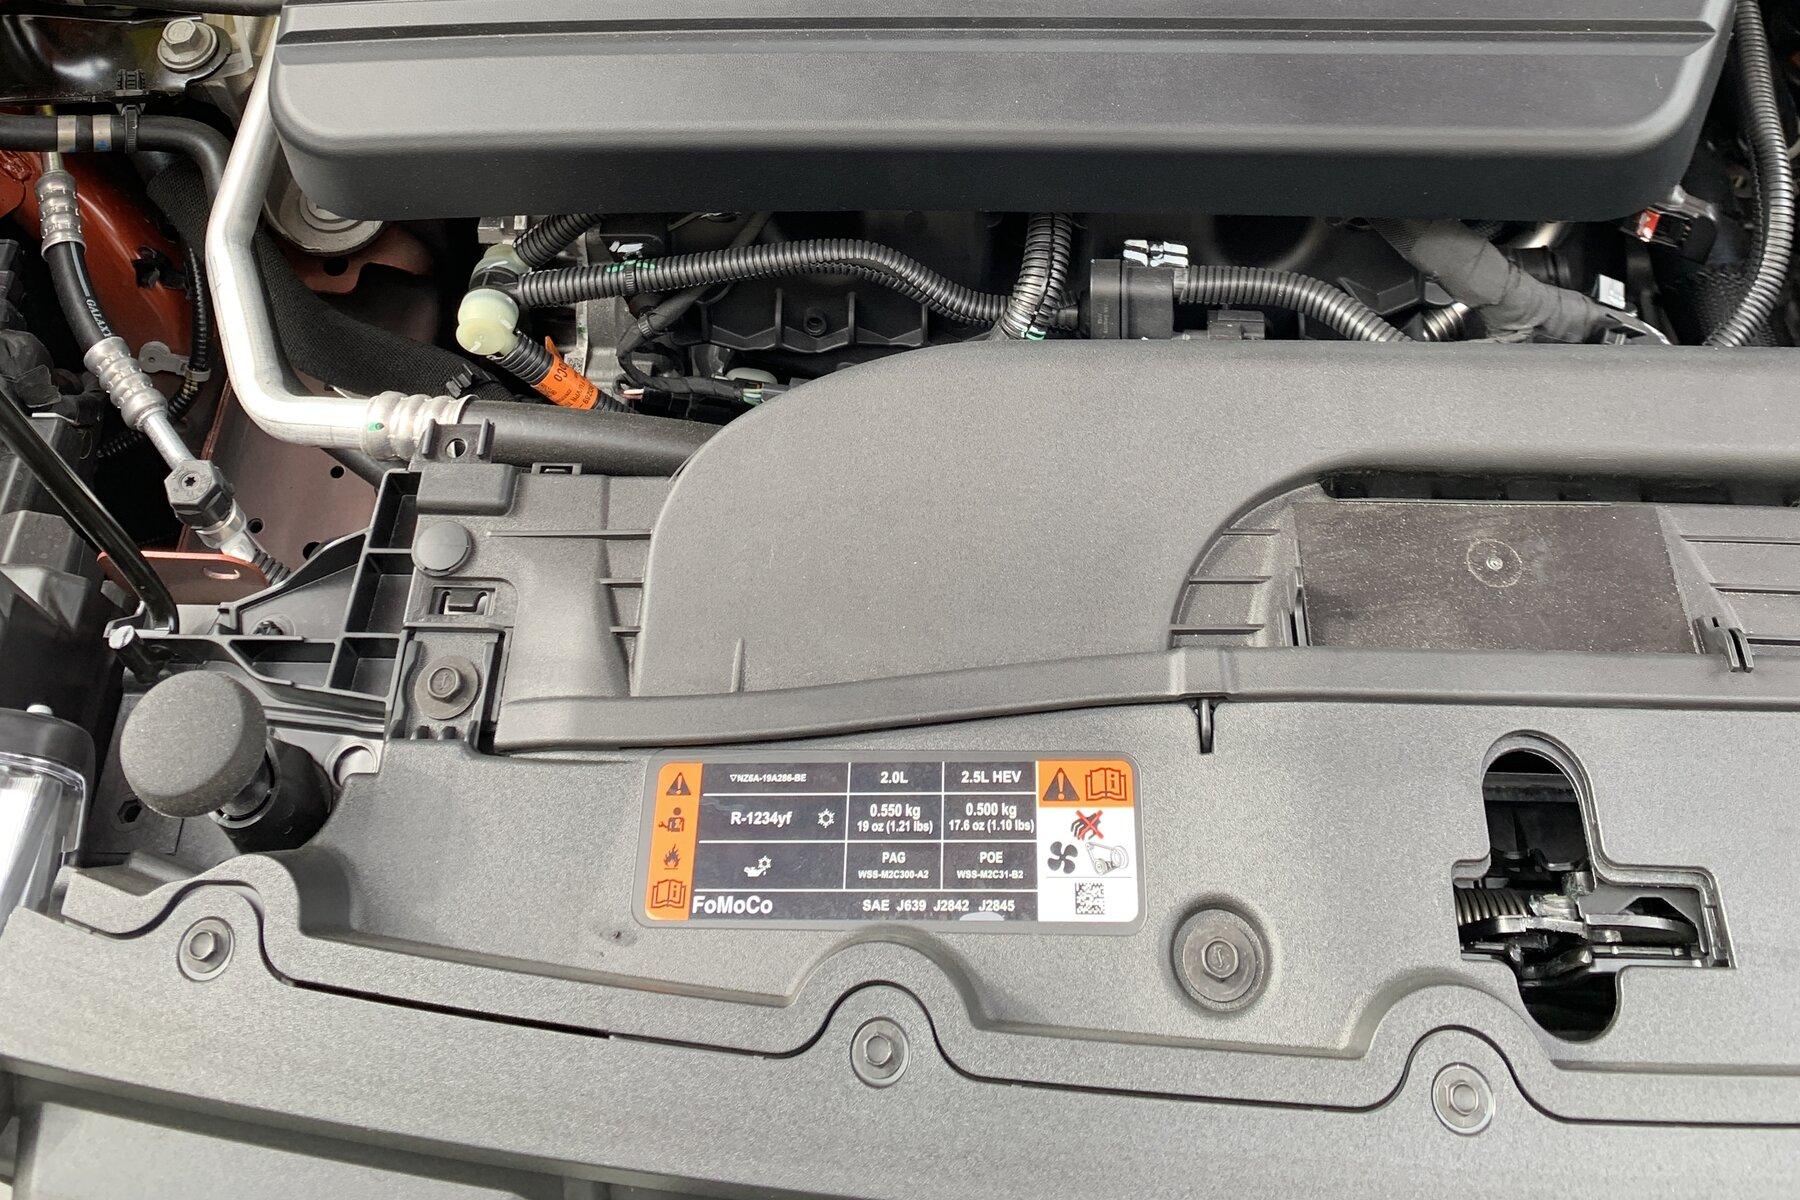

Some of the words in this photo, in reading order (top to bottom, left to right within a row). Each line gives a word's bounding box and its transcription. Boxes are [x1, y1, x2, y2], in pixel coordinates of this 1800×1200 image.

[879, 771, 909, 784] 2.0L
[960, 770, 990, 784] 2.5L
[992, 770, 1022, 784] HEV
[869, 803, 903, 817] 0.550
[905, 803, 921, 820] kg
[965, 802, 999, 817] 0.500
[1001, 802, 1017, 819] kg
[730, 810, 793, 828] R-1234yf
[856, 820, 870, 832] 19
[871, 822, 885, 832] oz
[886, 820, 911, 834] (1.21
[913, 820, 934, 834] lbs)
[949, 819, 971, 831] 17.6
[971, 822, 985, 831] oz
[986, 819, 1012, 834] (1.10
[1014, 819, 1035, 834] lbs)
[881, 851, 907, 864] PAG
[979, 851, 1004, 864] POE
[691, 894, 774, 914] FoMoCo
[862, 899, 890, 912] SAE
[896, 899, 927, 912] J639
[933, 899, 970, 912] J2842
[978, 899, 1016, 912] J2845
